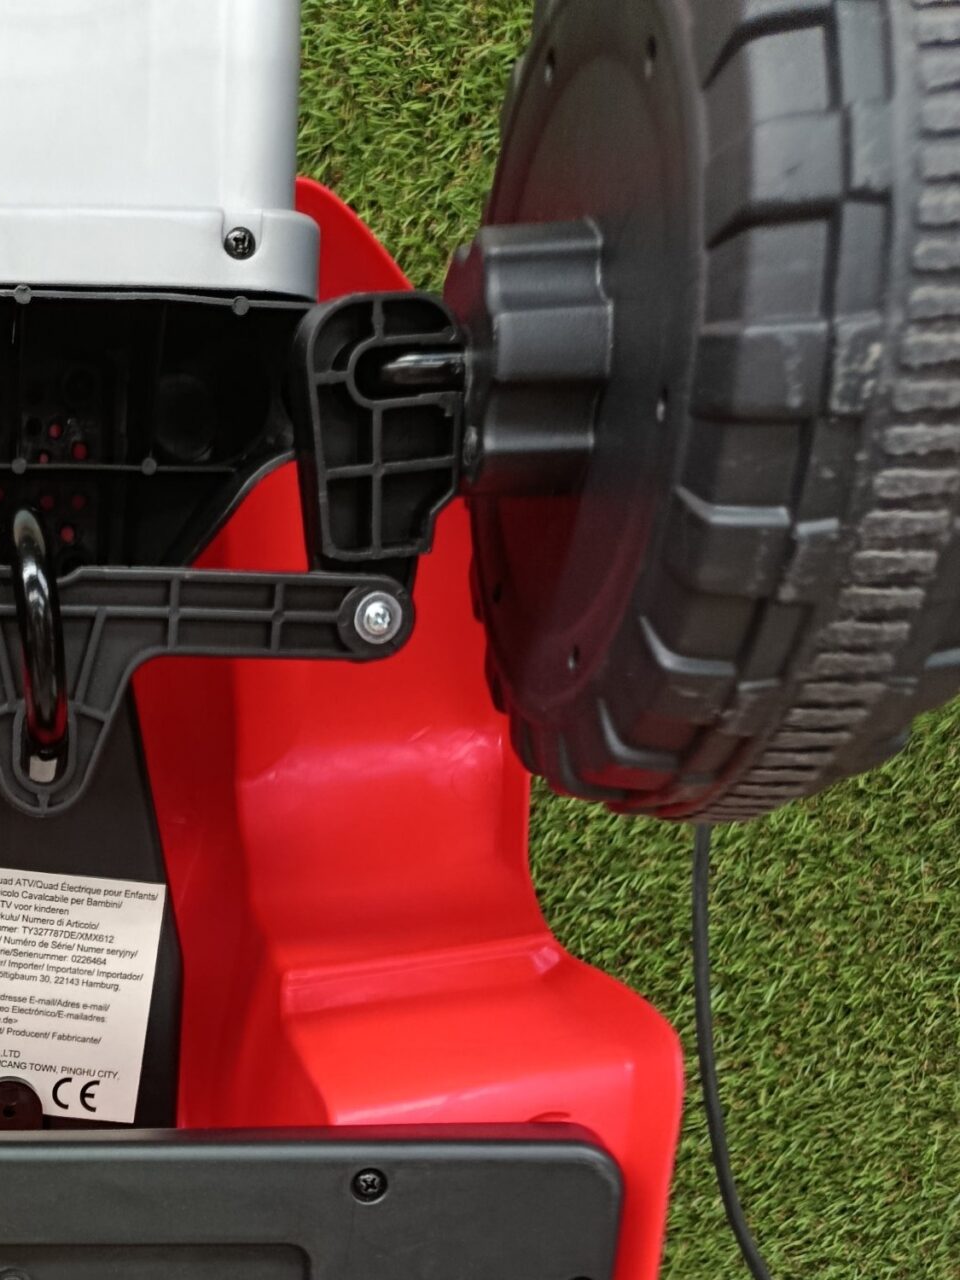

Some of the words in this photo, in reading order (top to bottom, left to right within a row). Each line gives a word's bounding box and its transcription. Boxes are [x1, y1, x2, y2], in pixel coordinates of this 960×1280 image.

[14, 878, 59, 891] ATV/Quad
[103, 889, 123, 897] pour
[124, 889, 159, 901] Enfants/
[21, 890, 69, 904] Cavalcabile
[70, 897, 85, 906] per
[13, 903, 33, 911] voor
[33, 903, 70, 916] kinderen
[21, 914, 55, 926] Numero
[56, 918, 65, 927] di
[65, 919, 100, 930] Articolo/
[38, 939, 49, 949] de
[50, 940, 76, 951] Série/
[76, 943, 105, 954] Numer
[8, 959, 45, 971] Importer/
[46, 963, 96, 976] Importatore/
[96, 968, 144, 981] Importador/
[54, 975, 80, 986] 22143
[6, 1027, 51, 1040] Producent/
[51, 1031, 102, 1045] Fabbricante/
[60, 1066, 96, 1077] PINGHU
[52, 1077, 100, 1112] CE
